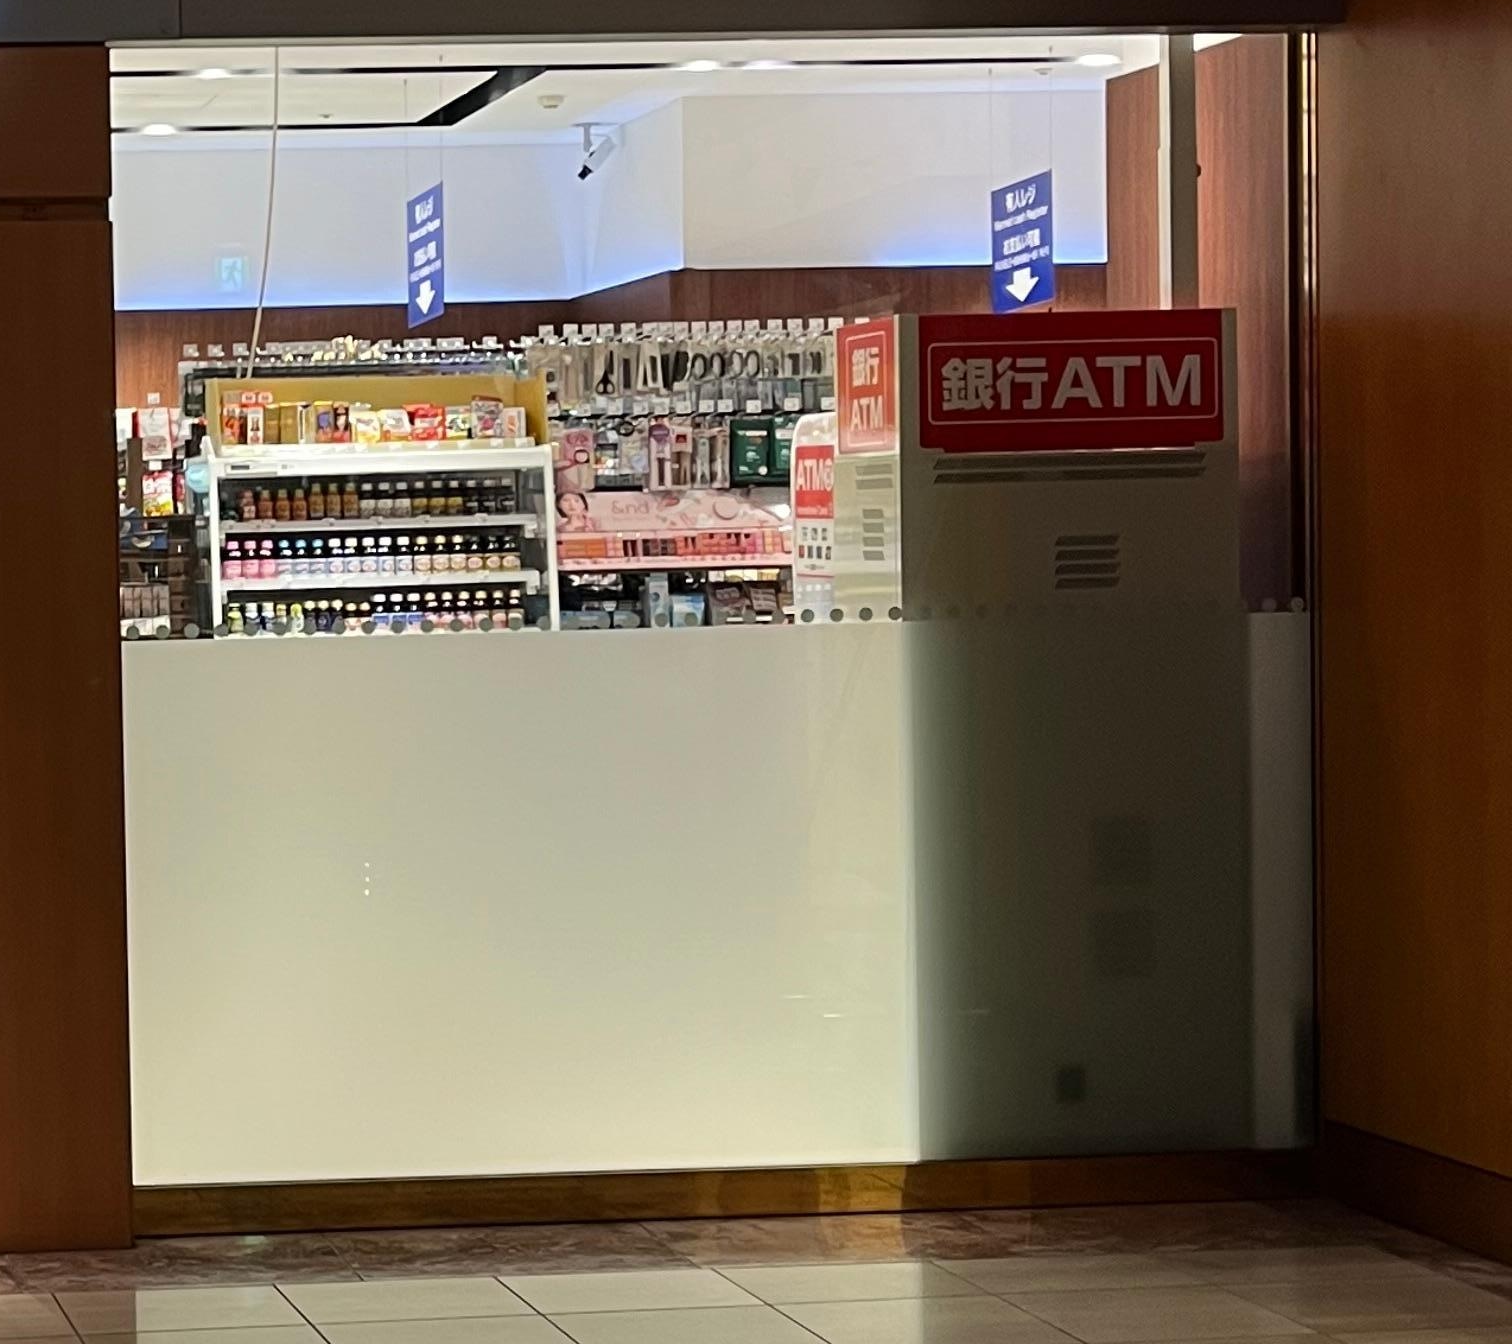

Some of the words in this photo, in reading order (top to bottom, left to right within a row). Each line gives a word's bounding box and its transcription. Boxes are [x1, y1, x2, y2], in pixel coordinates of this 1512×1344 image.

[852, 347, 879, 388] 銀行
[941, 353, 1202, 412] 銀行ATM
[850, 396, 884, 432] ATM
